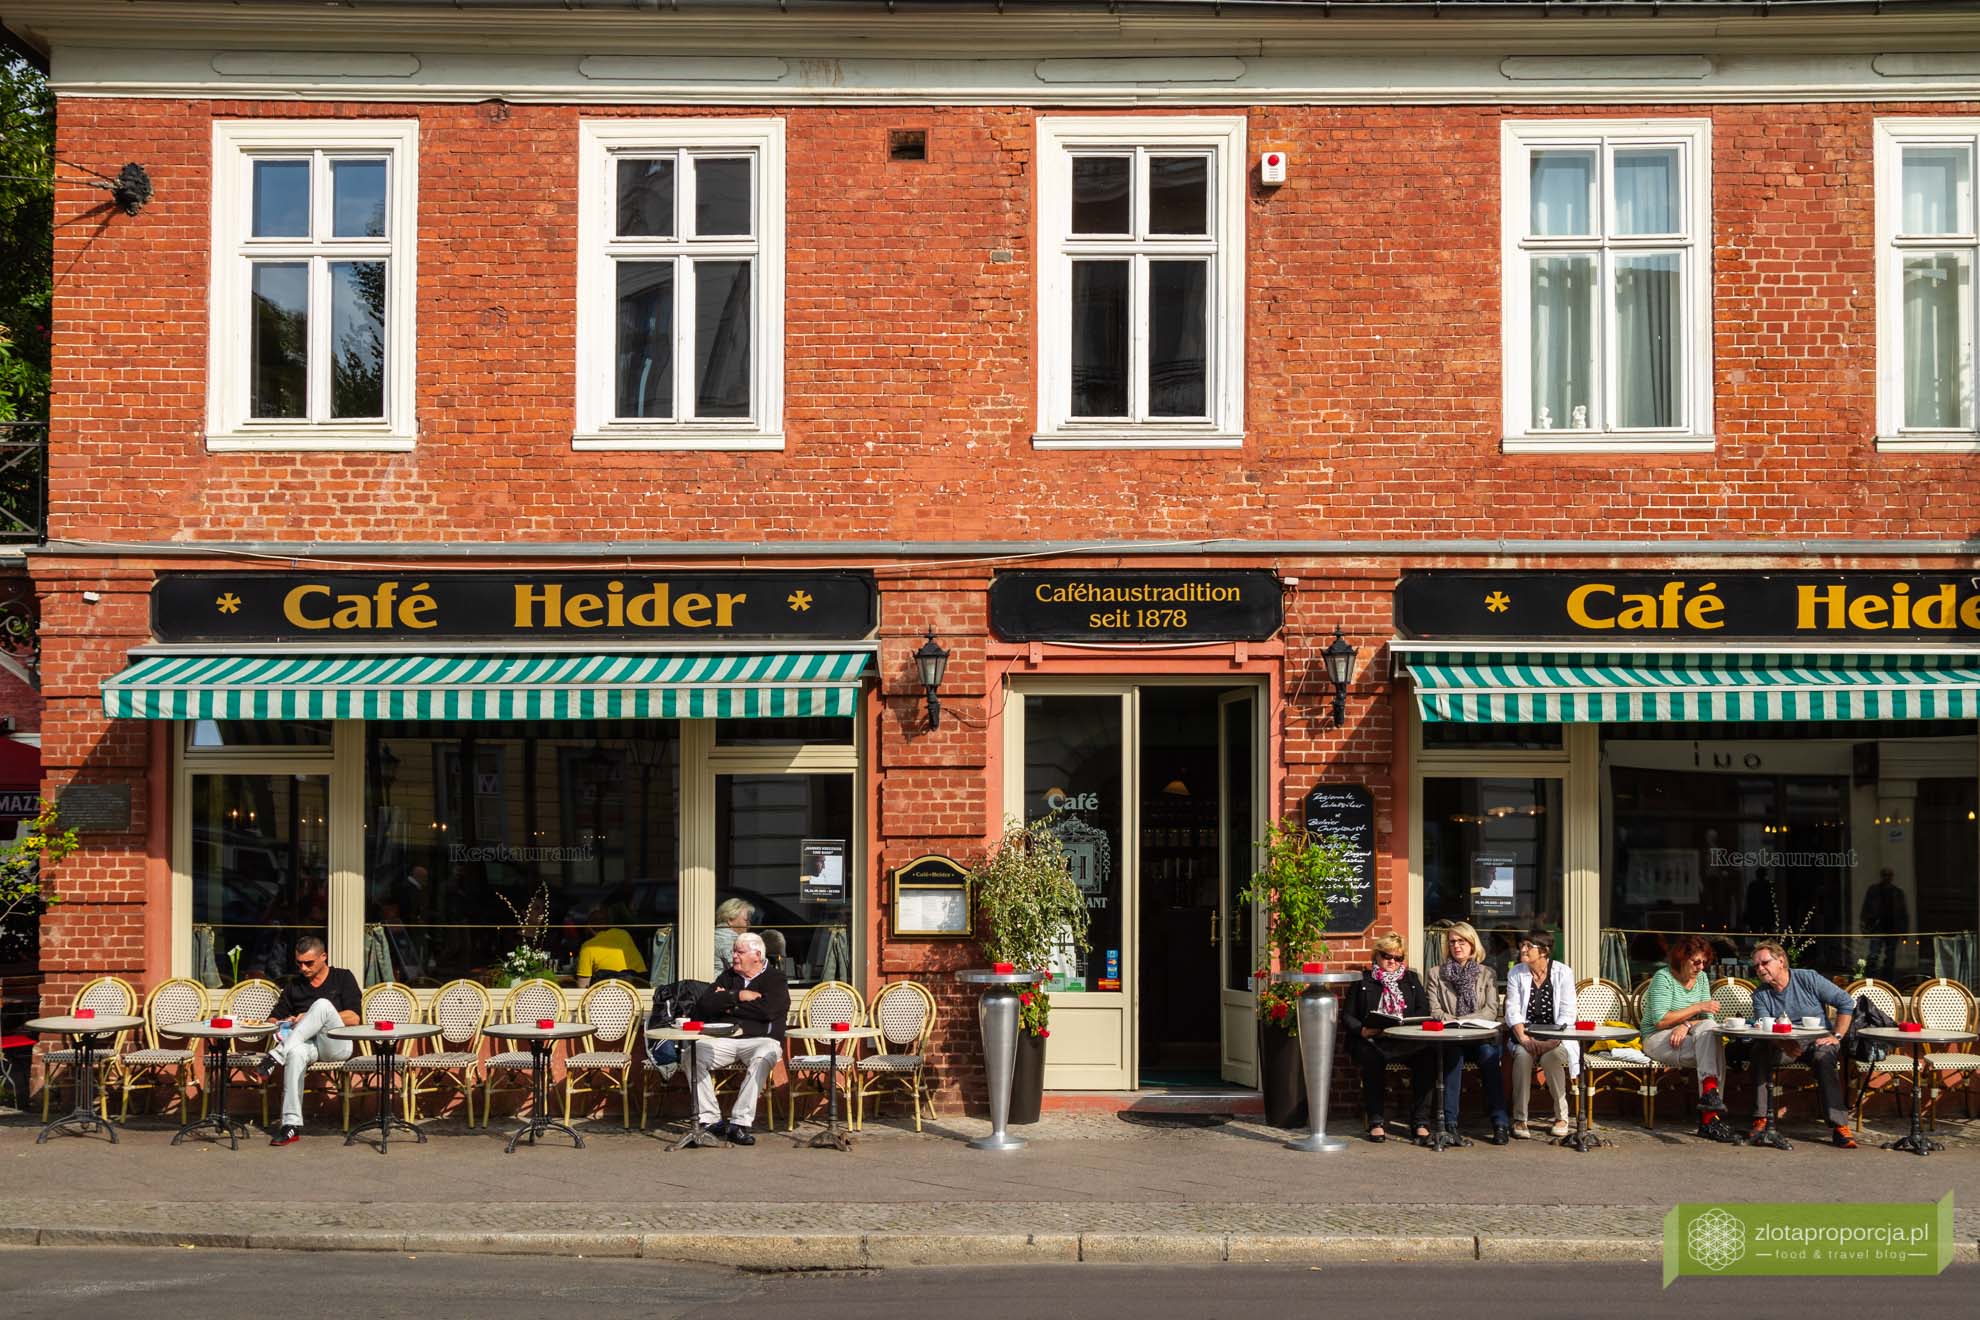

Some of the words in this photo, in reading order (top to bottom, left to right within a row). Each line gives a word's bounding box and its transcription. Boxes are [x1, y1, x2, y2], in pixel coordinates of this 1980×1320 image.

[1035, 582, 1241, 602] Caféhaustradition
[283, 581, 437, 630] Café
[514, 580, 747, 628] Heider
[1566, 581, 1725, 629] Café
[1089, 608, 1131, 628] seit
[1137, 609, 1188, 628] 1878
[1048, 793, 1100, 811] Café
[448, 843, 595, 863] Restaurant
[1710, 848, 1859, 868] Restaurant
